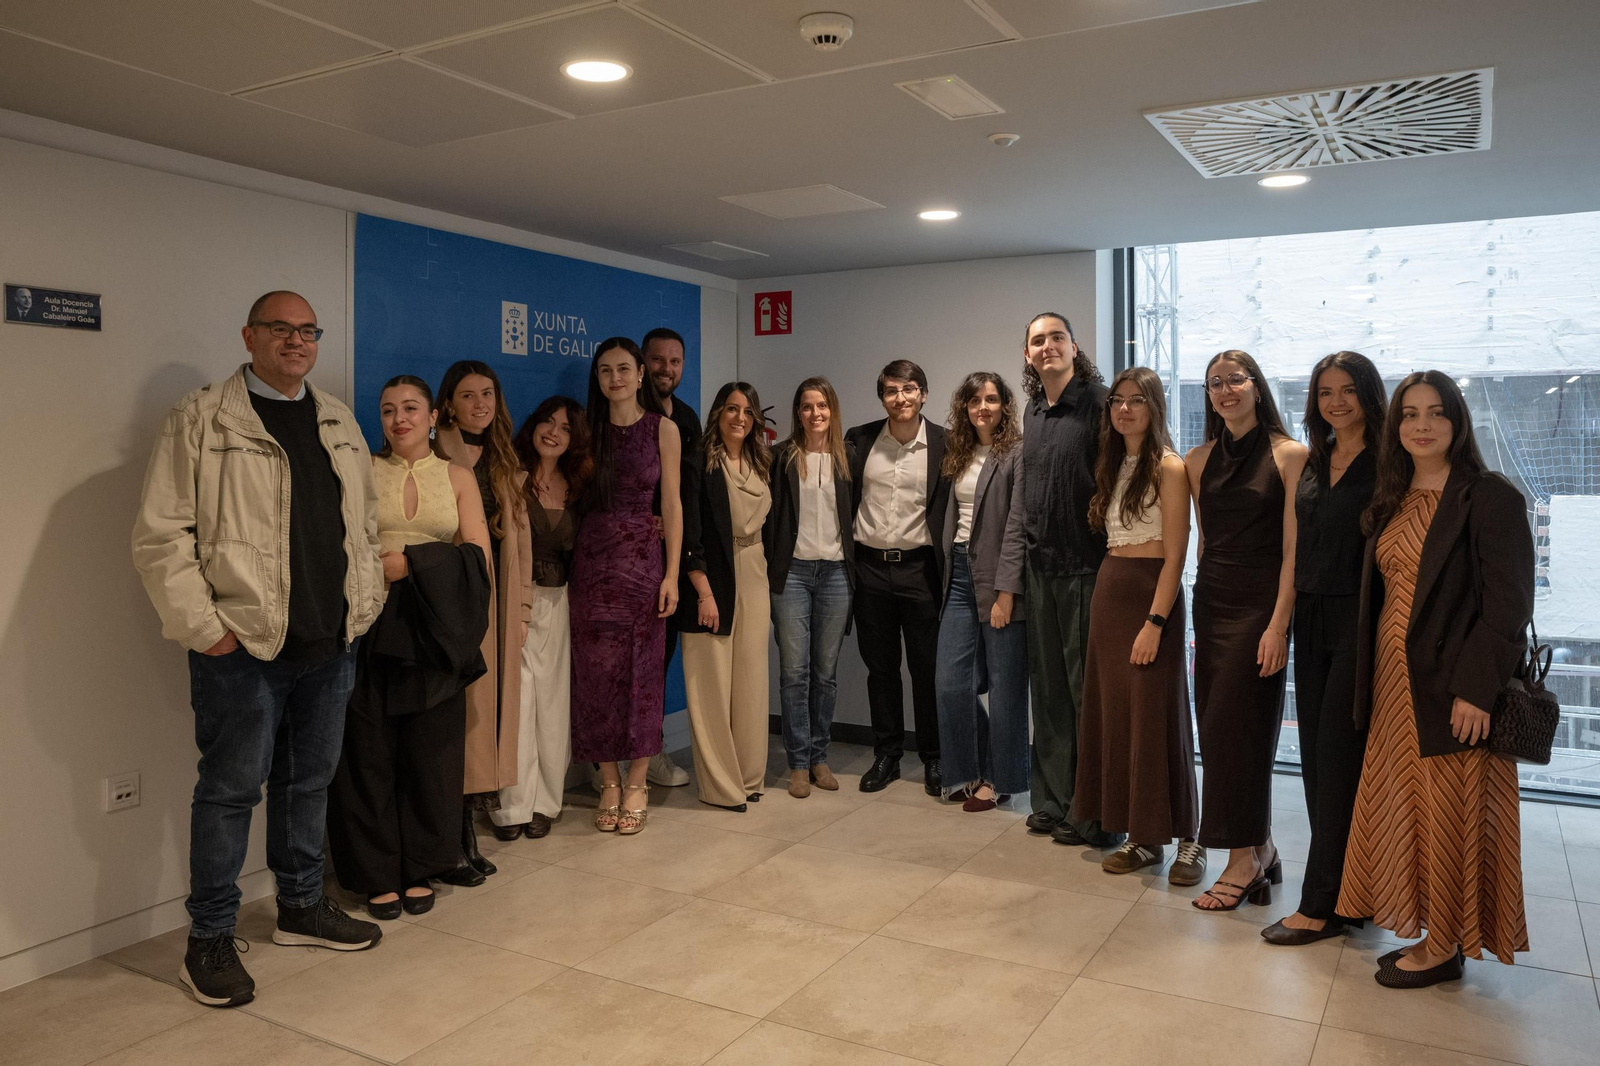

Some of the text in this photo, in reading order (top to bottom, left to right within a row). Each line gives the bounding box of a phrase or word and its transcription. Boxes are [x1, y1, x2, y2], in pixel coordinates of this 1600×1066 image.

[44, 296, 94, 307] Aula Docencia
[42, 312, 76, 321] Cabaleiro
[534, 310, 588, 335] XUNTA
[533, 333, 554, 354] DE
